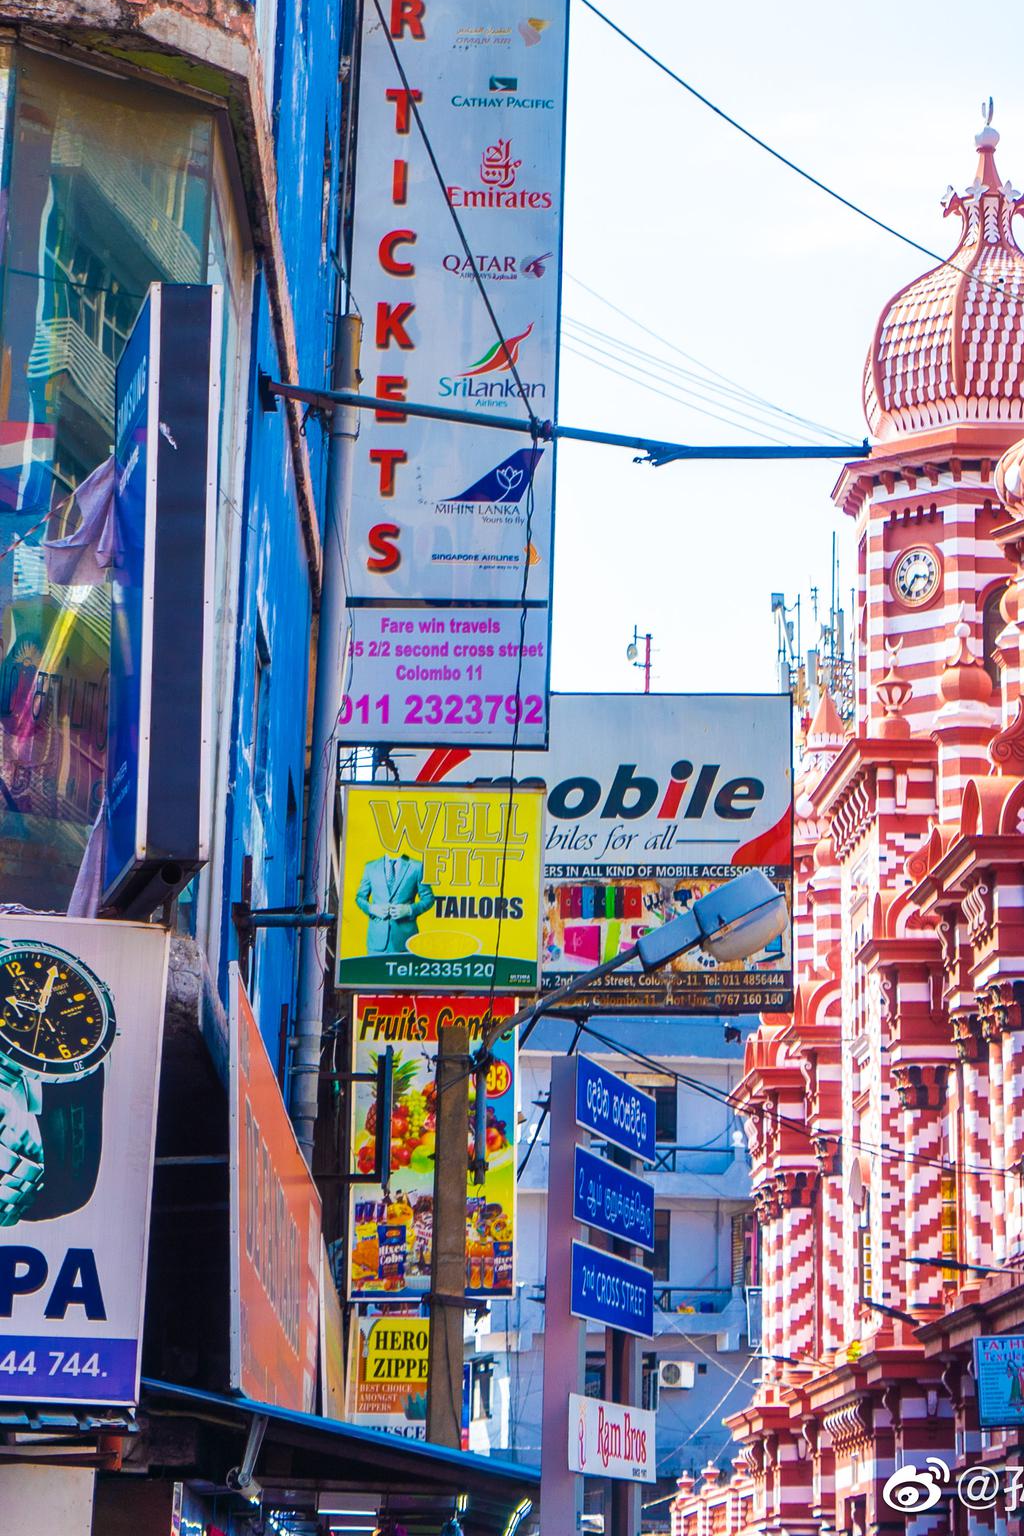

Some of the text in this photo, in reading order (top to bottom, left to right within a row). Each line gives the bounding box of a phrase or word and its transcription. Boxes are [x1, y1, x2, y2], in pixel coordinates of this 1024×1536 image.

[451, 95, 554, 110] CATHAY PACIFIC
[447, 186, 552, 209] Emirates
[442, 254, 517, 275] QATAR
[366, 88, 422, 573] TICKETS
[438, 376, 546, 399] SriLankan
[475, 398, 508, 408] Airlines
[434, 503, 520, 515] MIHIN LANKA
[482, 515, 503, 524] Yours
[505, 515, 513, 524] to
[431, 553, 519, 562] SINGAPORE AIRLINES
[381, 618, 501, 634] Fare win travels
[368, 641, 391, 657] 2/2
[395, 641, 449, 657] second
[453, 644, 494, 657] cross
[499, 641, 544, 658] street
[396, 665, 483, 681] Colombo 11
[404, 694, 543, 725] 2323792
[470, 759, 765, 820] obile
[369, 800, 528, 853] WELL
[594, 824, 639, 860] for
[644, 824, 679, 851] all
[420, 847, 525, 887] FIT
[566, 866, 579, 877] IN
[583, 866, 602, 877] ALL
[606, 866, 635, 877] KIND
[638, 866, 653, 877] OF
[656, 866, 699, 877] MOBILE
[702, 866, 775, 878] ACCESSOIES
[434, 896, 523, 920] TAILORS
[554, 974, 573, 985] 2nd
[604, 974, 636, 987] Street,
[703, 974, 720, 985] Tel:
[722, 974, 741, 985] 011
[743, 974, 784, 985] 4856444
[715, 994, 739, 1005] 0767
[743, 994, 762, 1005] 160
[764, 994, 784, 1005] 160
[359, 1006, 429, 1041] Fruits
[578, 1167, 586, 1201] 2
[379, 1244, 406, 1256] Mixed
[0, 1245, 107, 1321] PA
[581, 1265, 647, 1317] 2nd CROSS STREET
[375, 1330, 428, 1351] HERO
[360, 1384, 412, 1393] BEST CHOICE
[360, 1393, 397, 1402] AMONGST
[359, 1402, 391, 1411] ZIPPERS
[597, 1406, 647, 1467] Ram Bros
